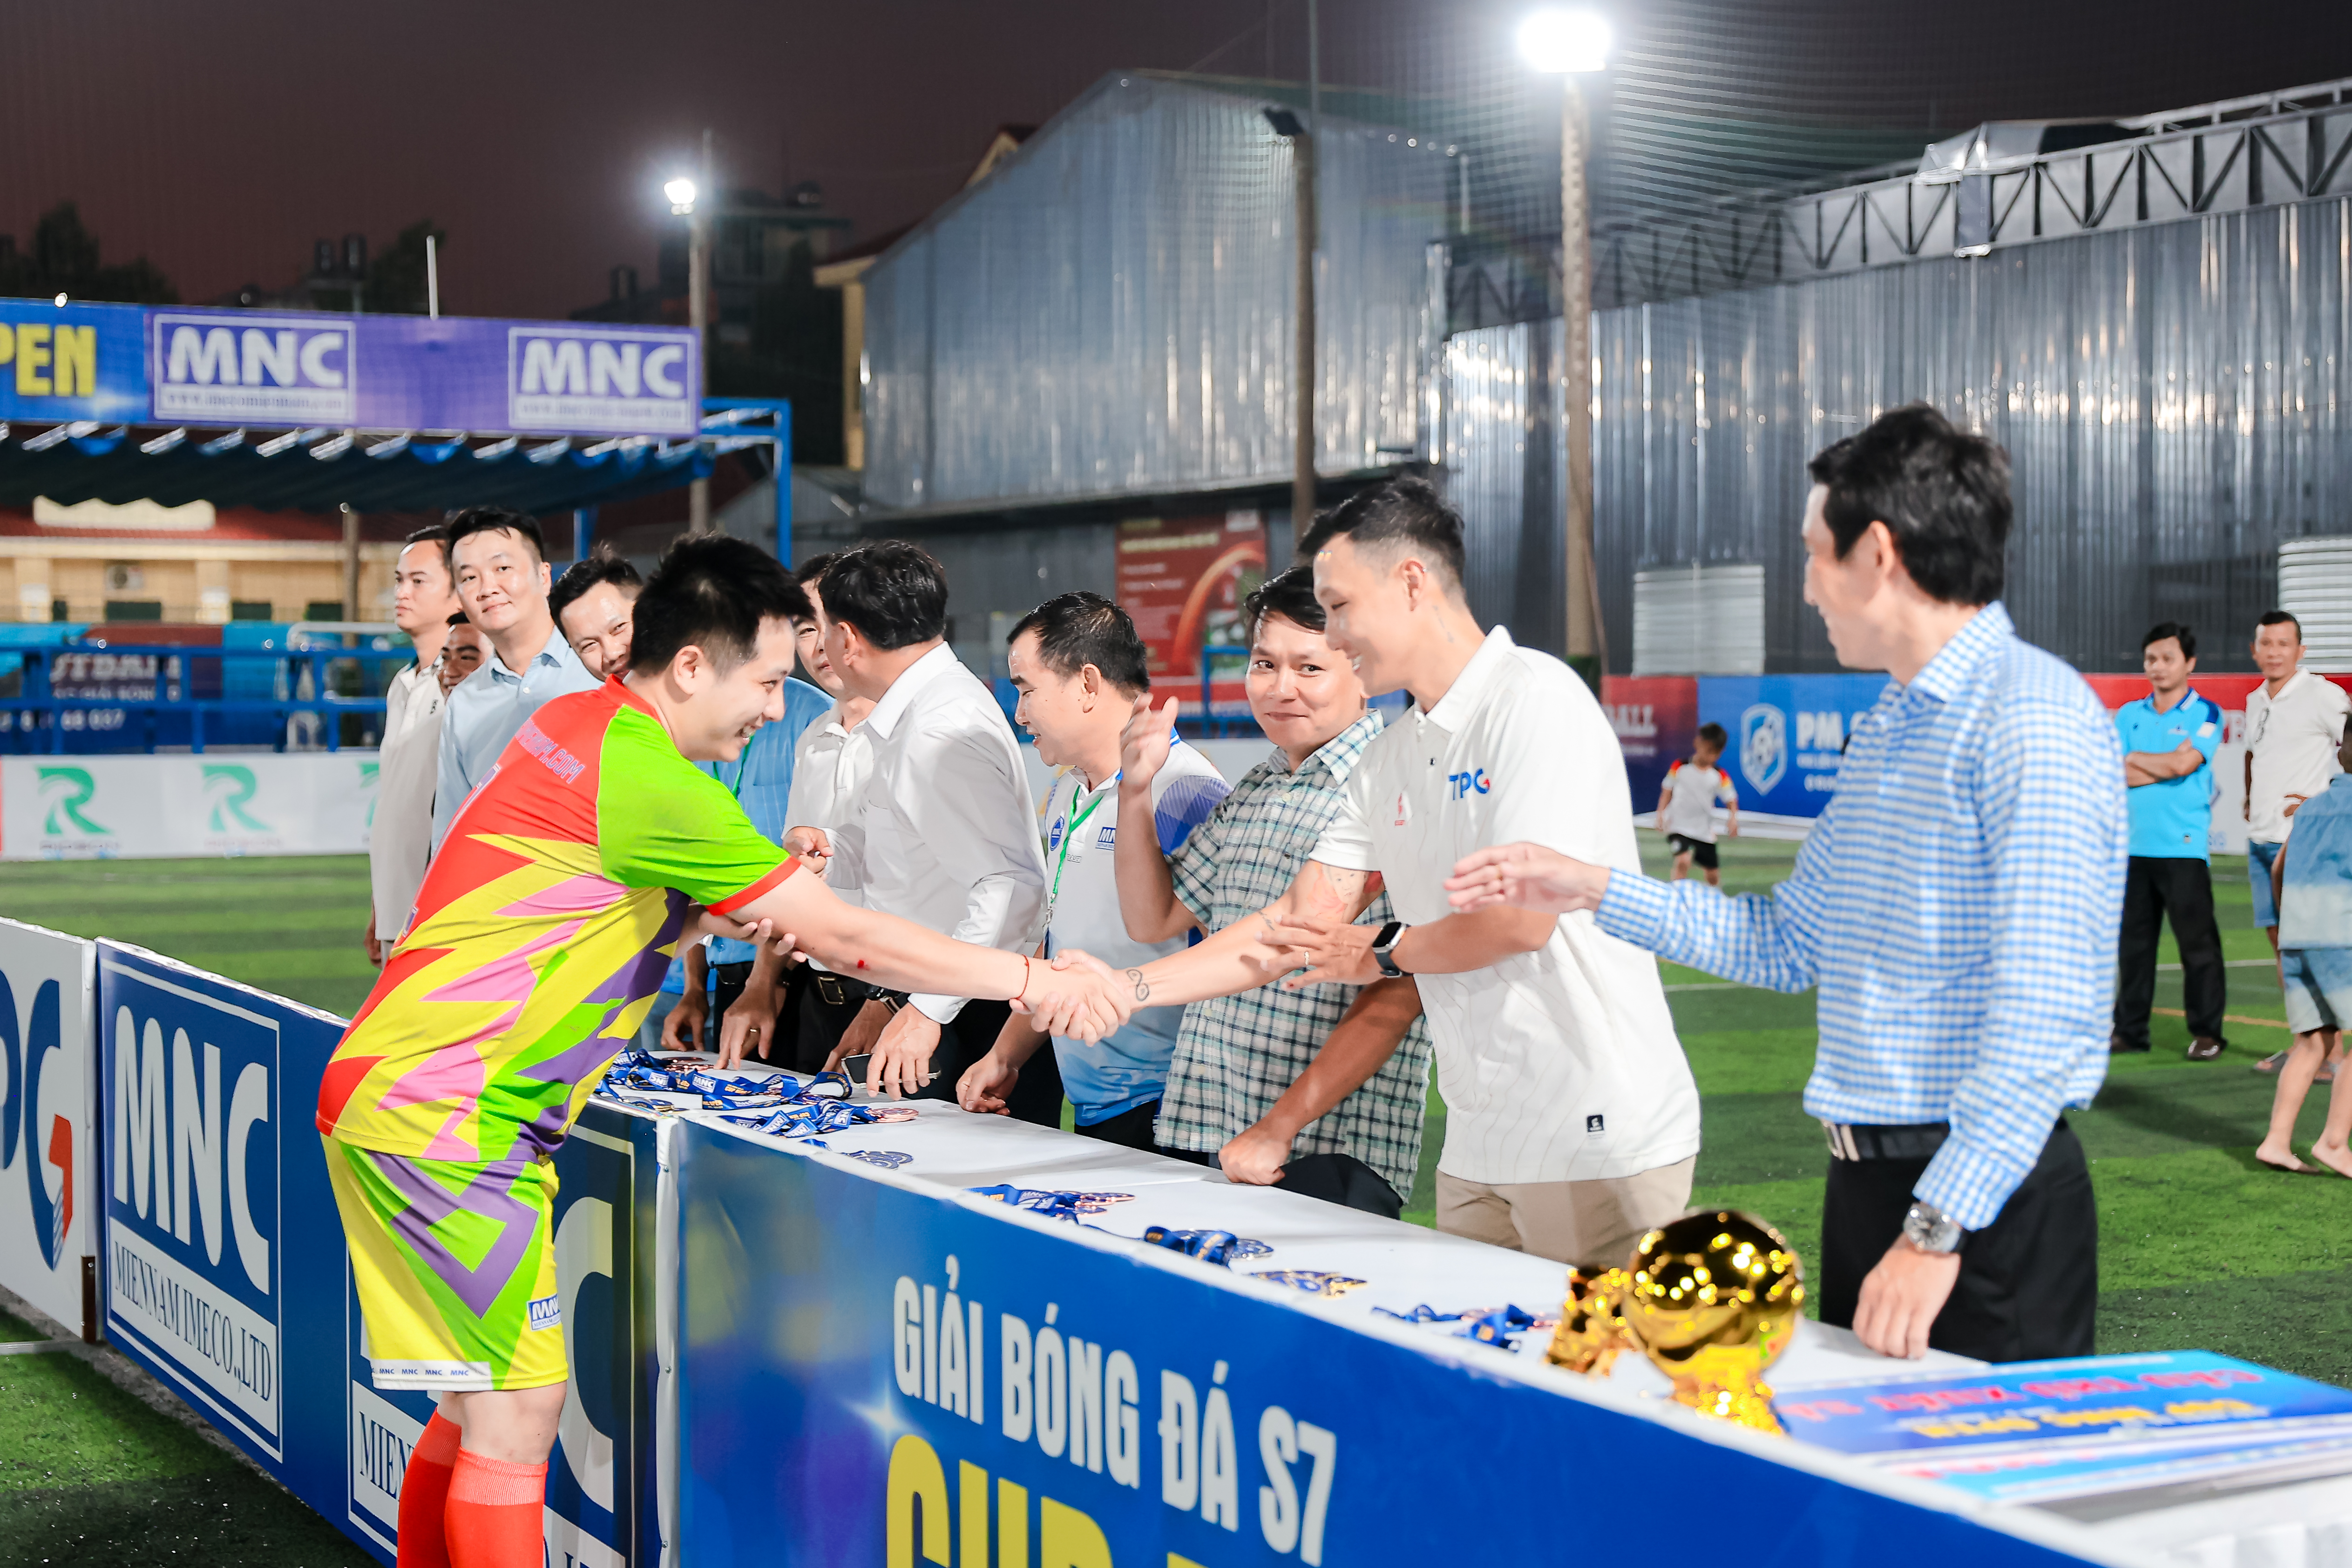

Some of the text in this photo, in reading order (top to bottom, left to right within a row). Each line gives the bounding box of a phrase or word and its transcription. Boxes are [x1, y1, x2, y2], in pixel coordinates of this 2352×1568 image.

[168, 326, 344, 387] MNC
[520, 339, 684, 399] MNC
[1449, 767, 1490, 801] TPG
[114, 1005, 269, 1295] MNC
[893, 1254, 1337, 1568] GIẢI BÓNG ĐÁ S7
